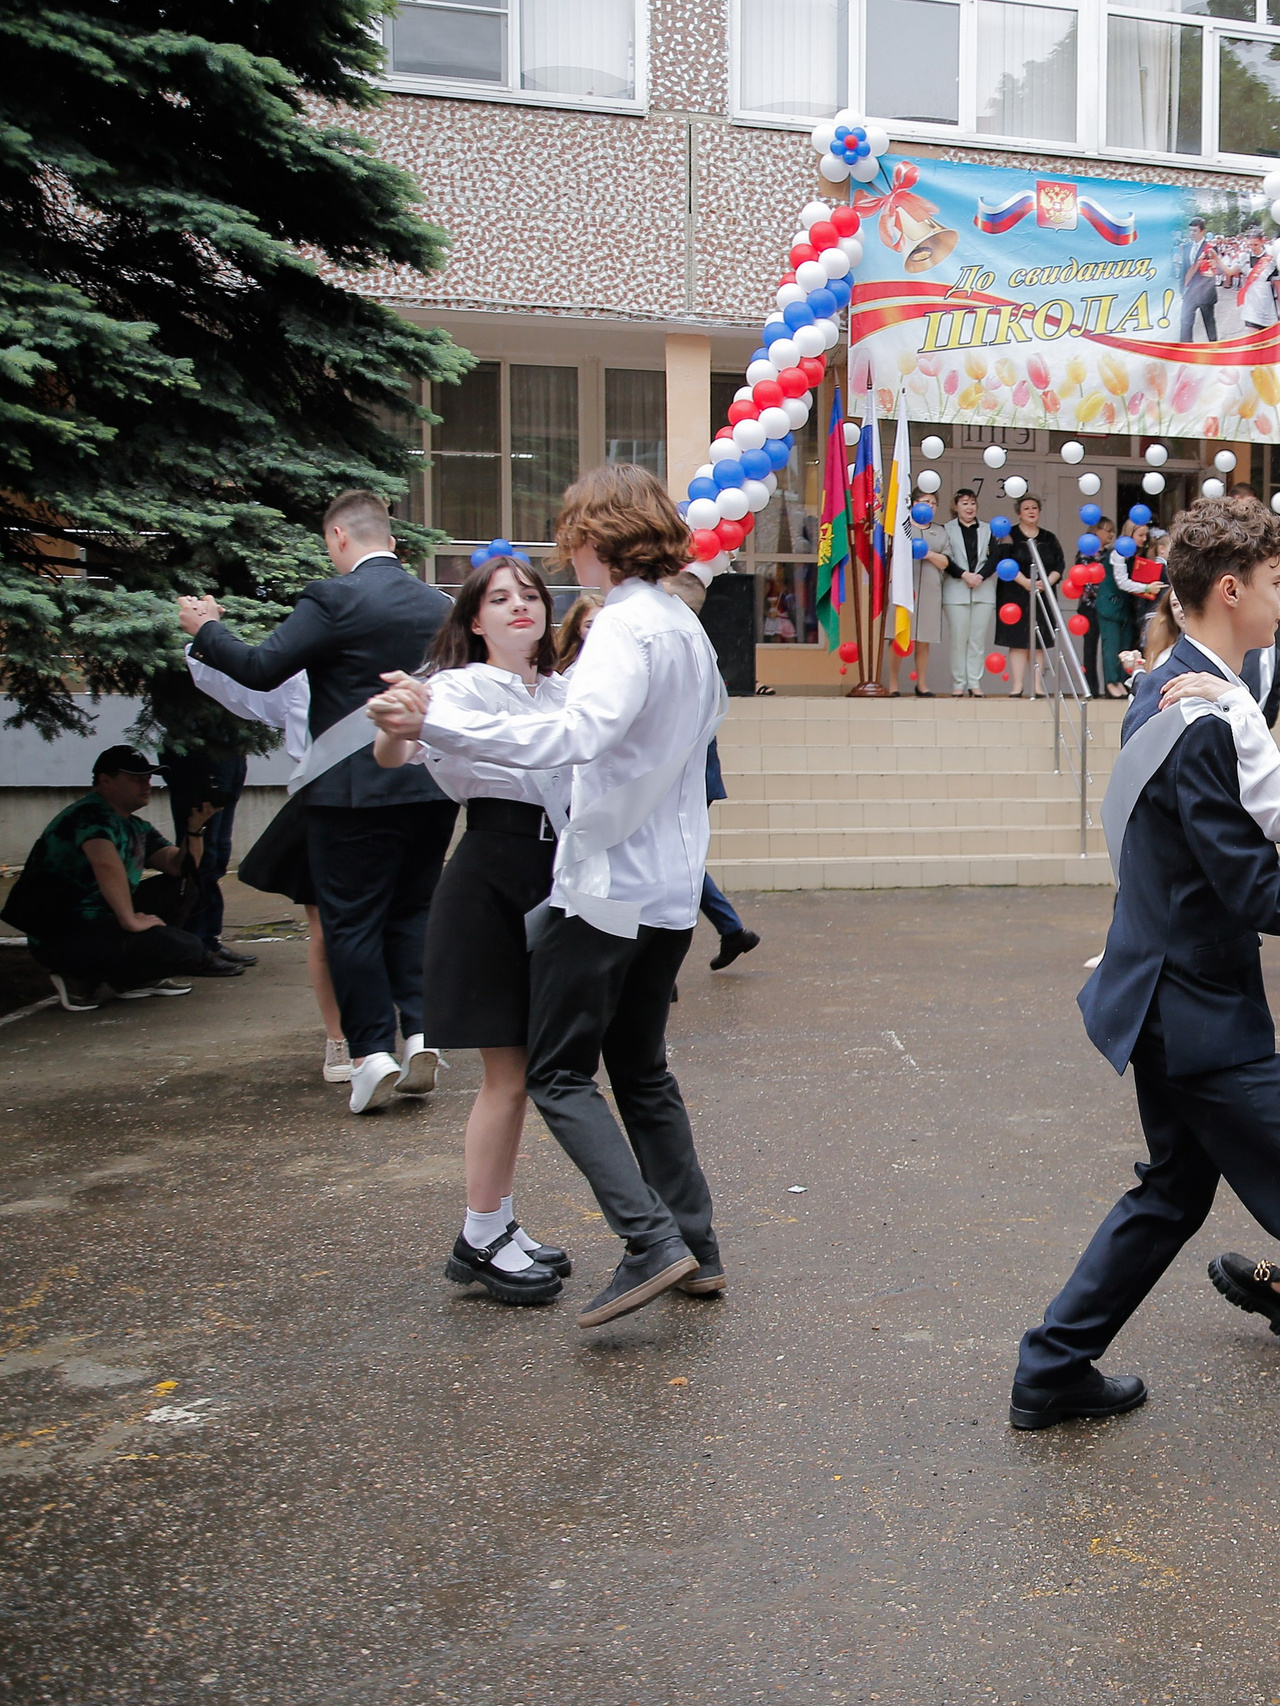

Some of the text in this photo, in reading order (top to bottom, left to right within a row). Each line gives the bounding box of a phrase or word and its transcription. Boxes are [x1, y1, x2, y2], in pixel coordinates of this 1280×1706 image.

[944, 257, 1157, 299] До свидания,
[917, 289, 1174, 353] ШКОЛА!
